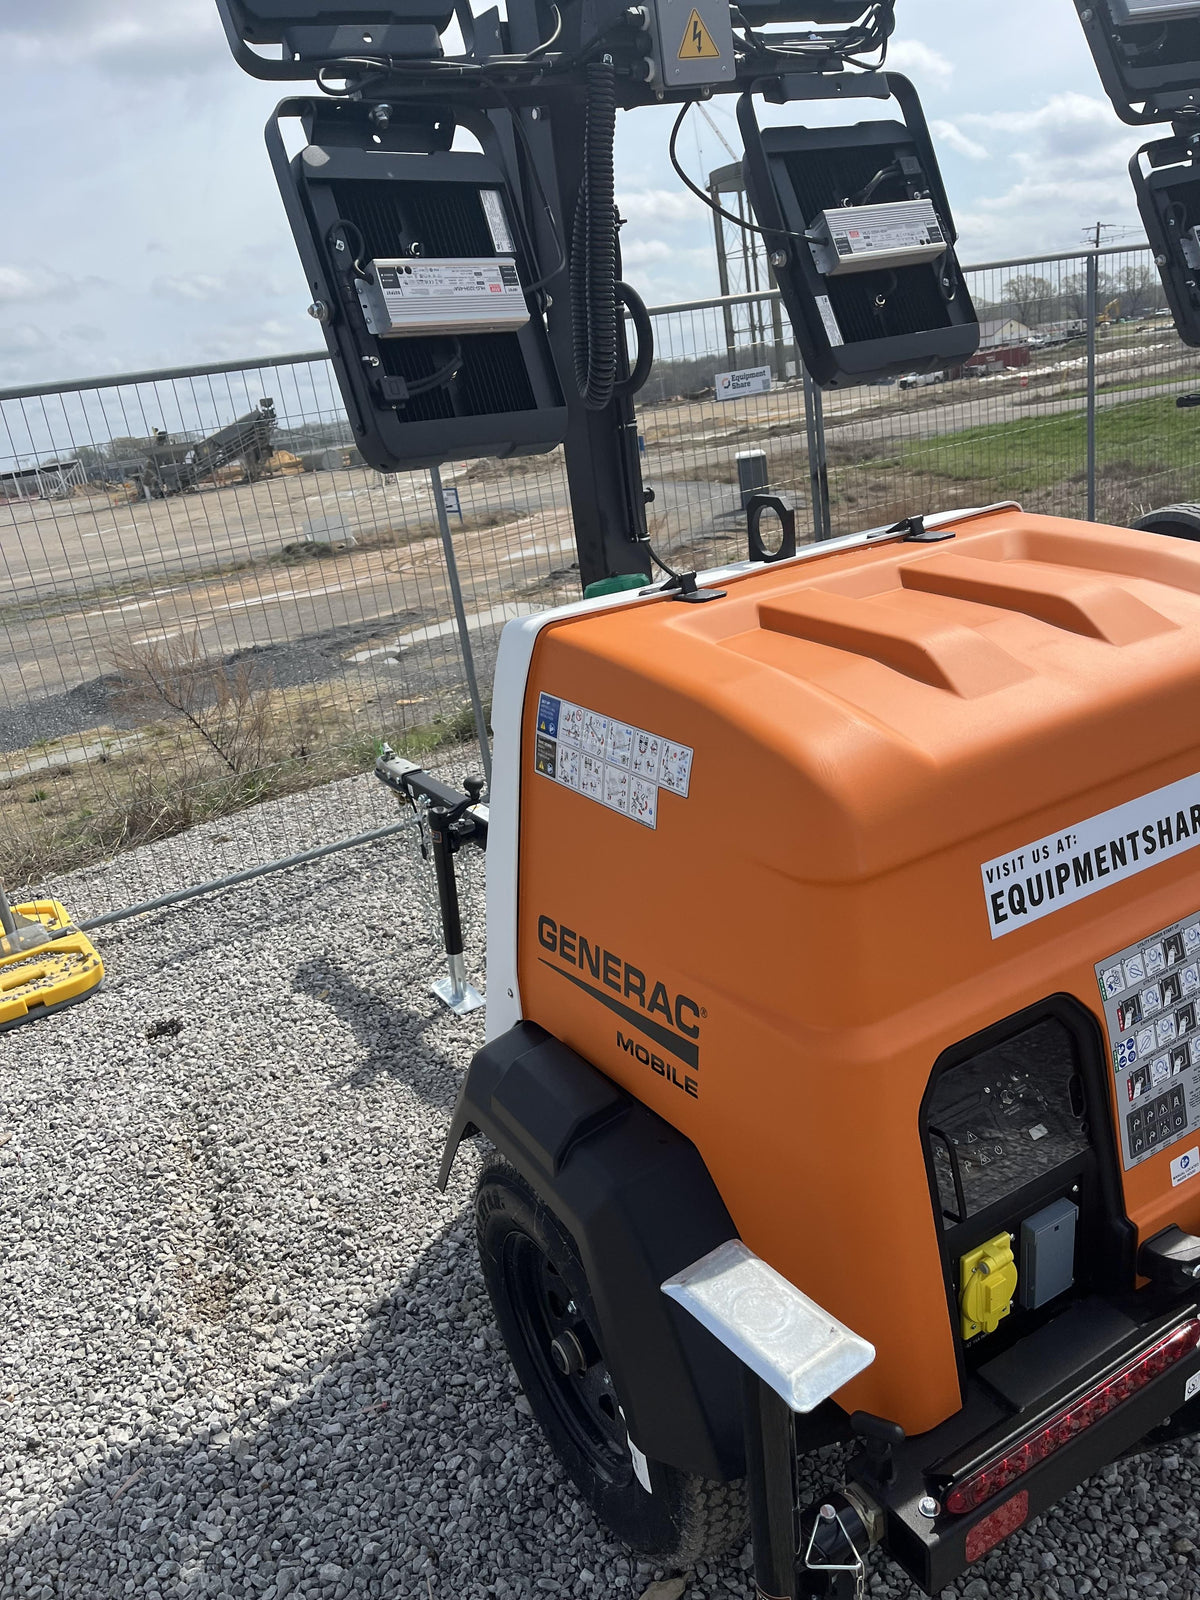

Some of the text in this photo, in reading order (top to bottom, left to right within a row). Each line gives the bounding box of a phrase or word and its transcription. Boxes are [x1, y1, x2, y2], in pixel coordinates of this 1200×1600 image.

[731, 370, 766, 382] Equipment
[731, 381, 751, 390] Share
[986, 834, 1077, 884] VISIT US AT:
[616, 1030, 698, 1100] MOBILE
